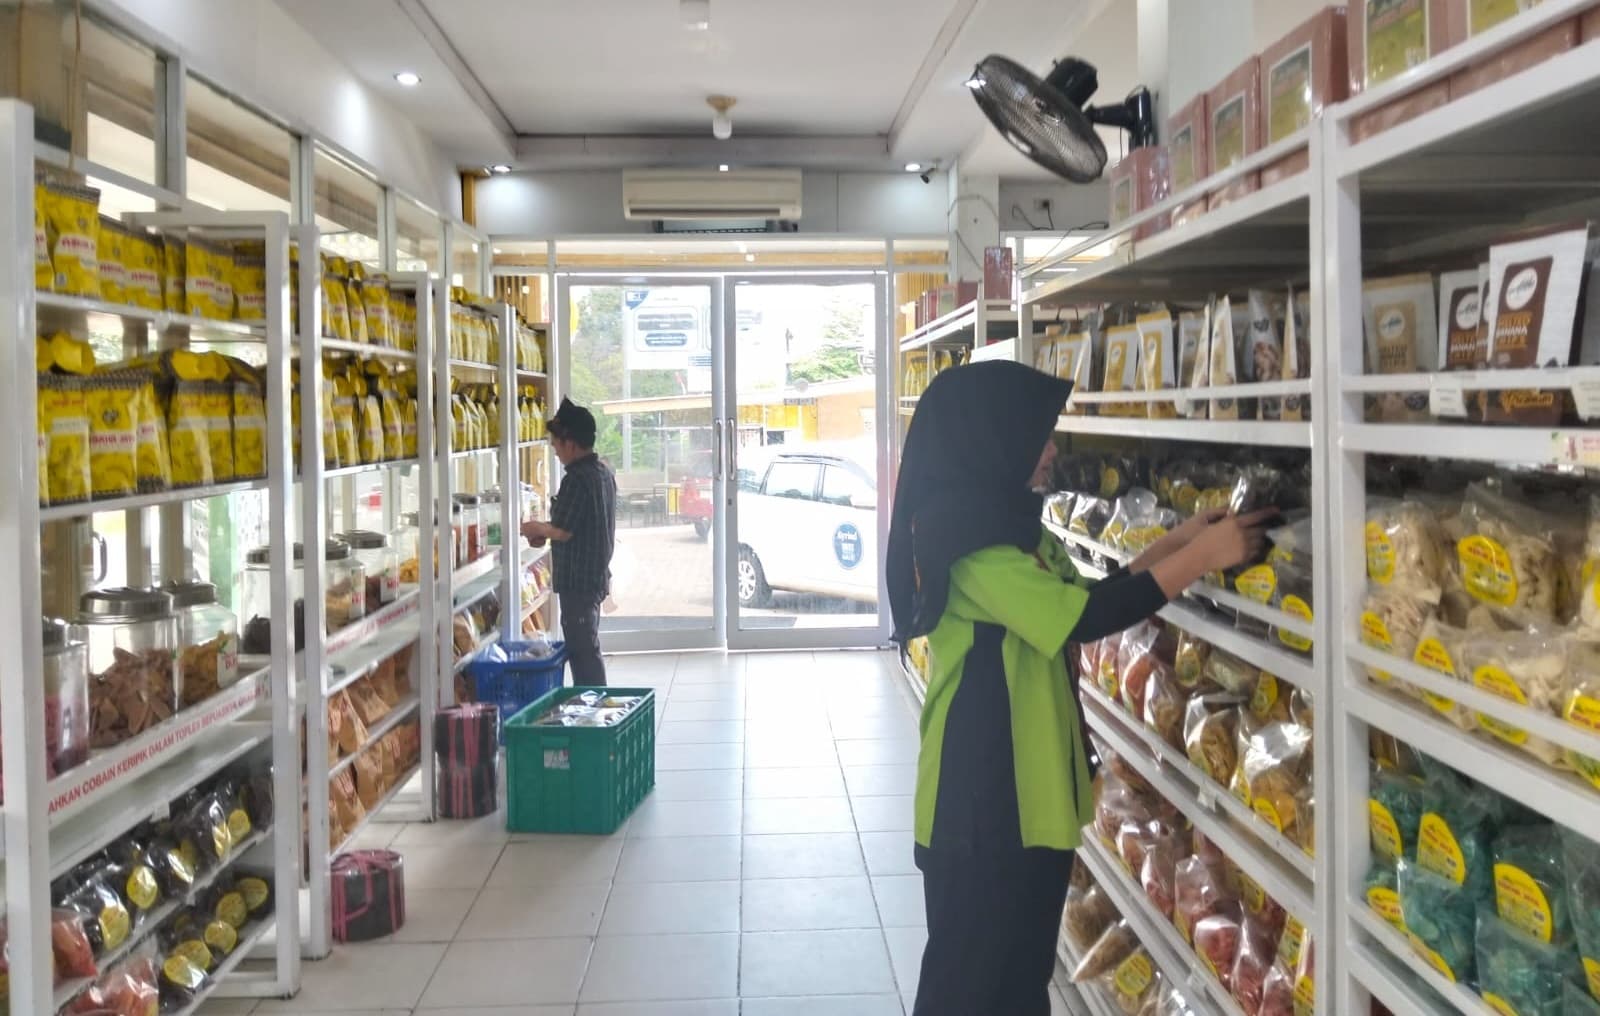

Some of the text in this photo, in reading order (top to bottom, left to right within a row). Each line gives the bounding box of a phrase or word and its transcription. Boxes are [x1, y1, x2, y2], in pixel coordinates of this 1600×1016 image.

[48, 787, 81, 813] AHKAN
[83, 765, 116, 792] COBAIN
[117, 751, 148, 774] KERIPIK
[149, 734, 174, 755] DALAM
